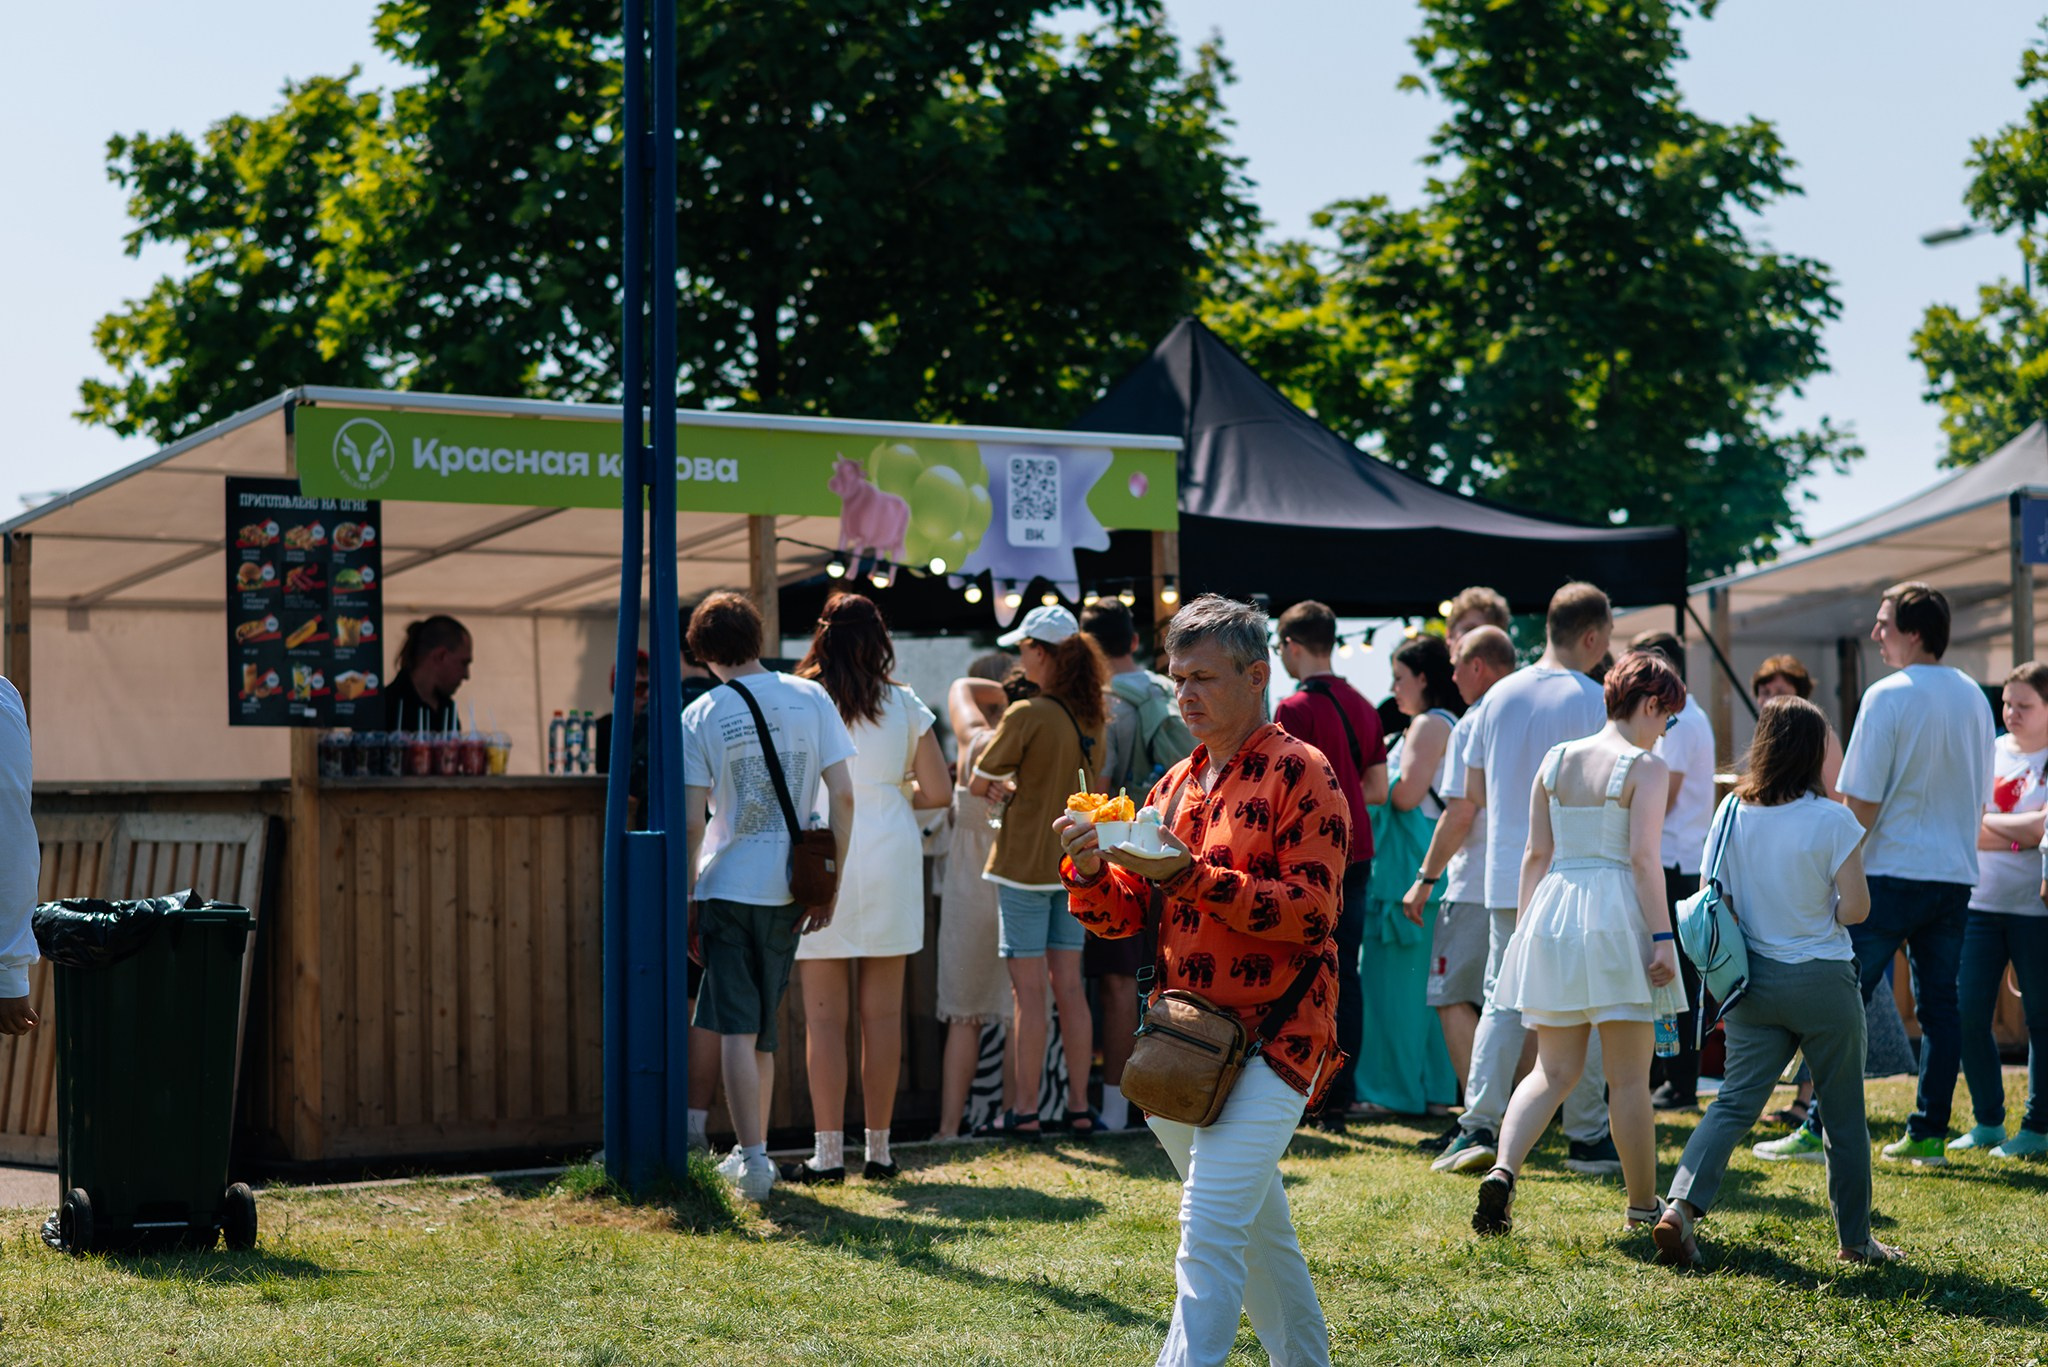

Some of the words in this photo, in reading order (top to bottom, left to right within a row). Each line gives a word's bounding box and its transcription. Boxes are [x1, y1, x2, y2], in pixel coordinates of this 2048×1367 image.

[413, 437, 590, 477] Красная
[598, 453, 738, 482] кова
[1025, 528, 1045, 541] ВК
